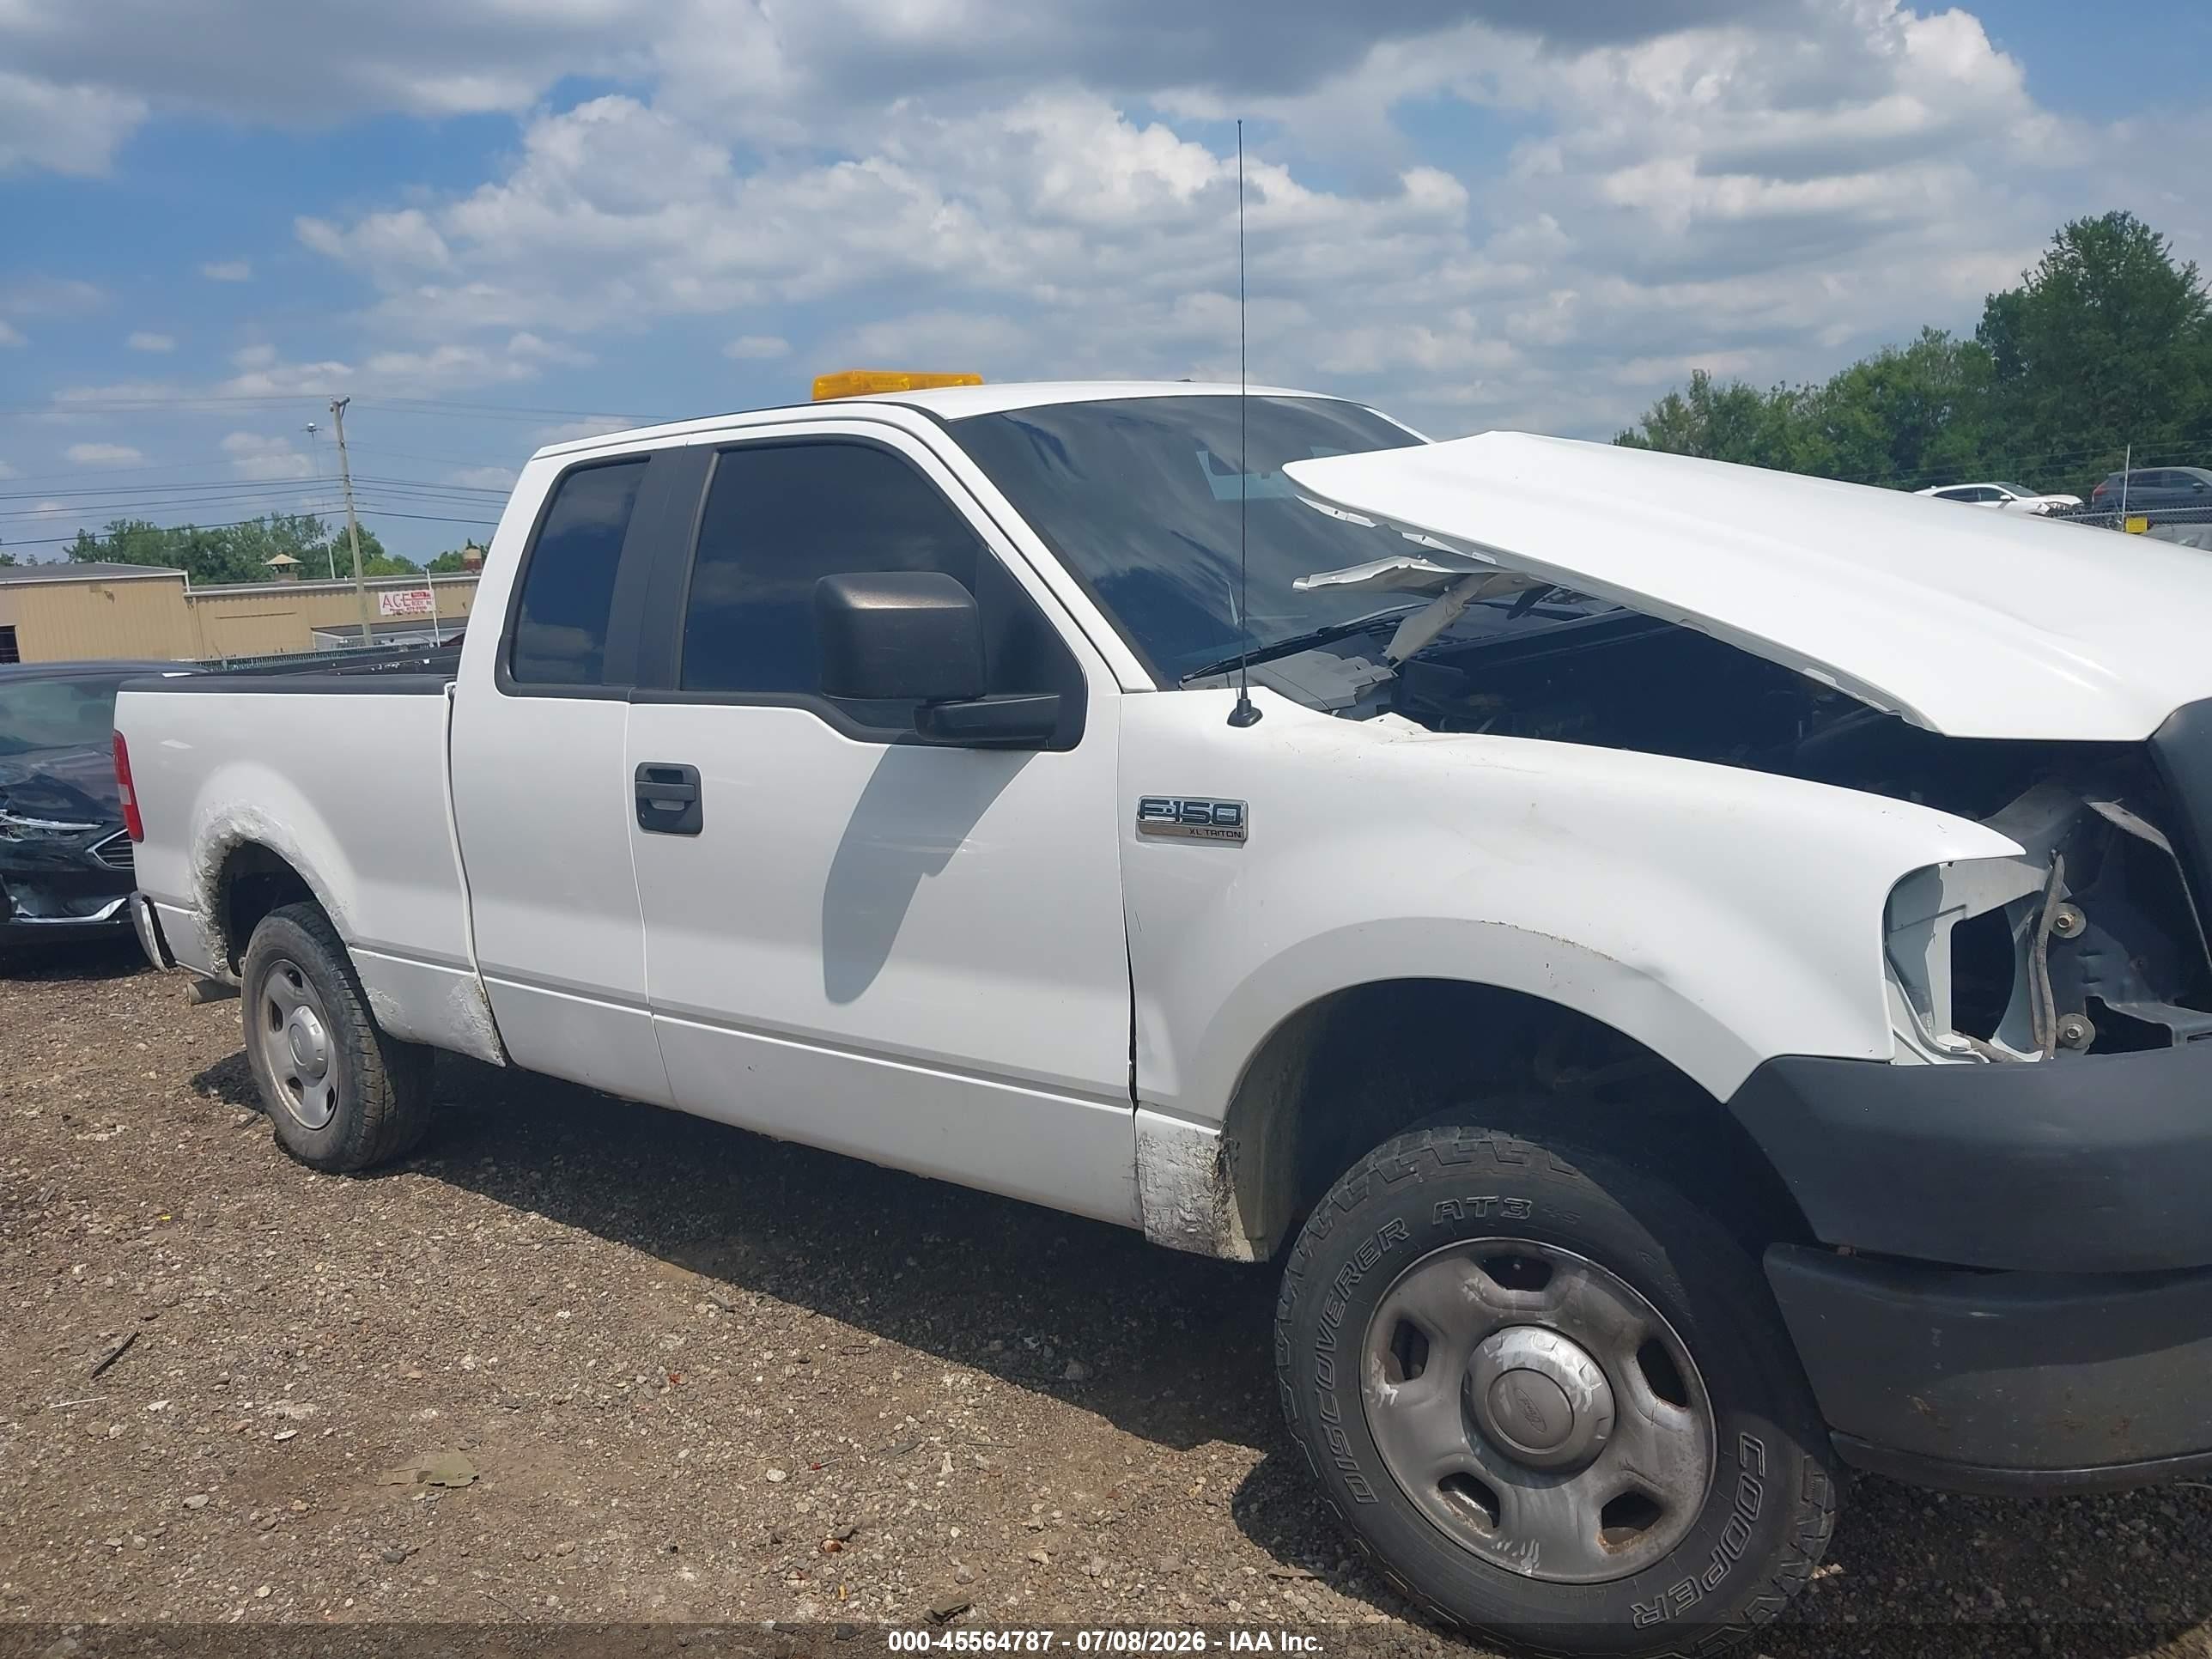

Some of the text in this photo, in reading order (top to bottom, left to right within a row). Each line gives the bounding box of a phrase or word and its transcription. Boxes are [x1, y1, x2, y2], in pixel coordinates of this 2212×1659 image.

[382, 592, 410, 609] ACE
[1188, 827, 1242, 838] XL TRITON
[1314, 1195, 1533, 1504] DISCOVERER AT3
[1630, 1431, 1765, 1629] COOPER
